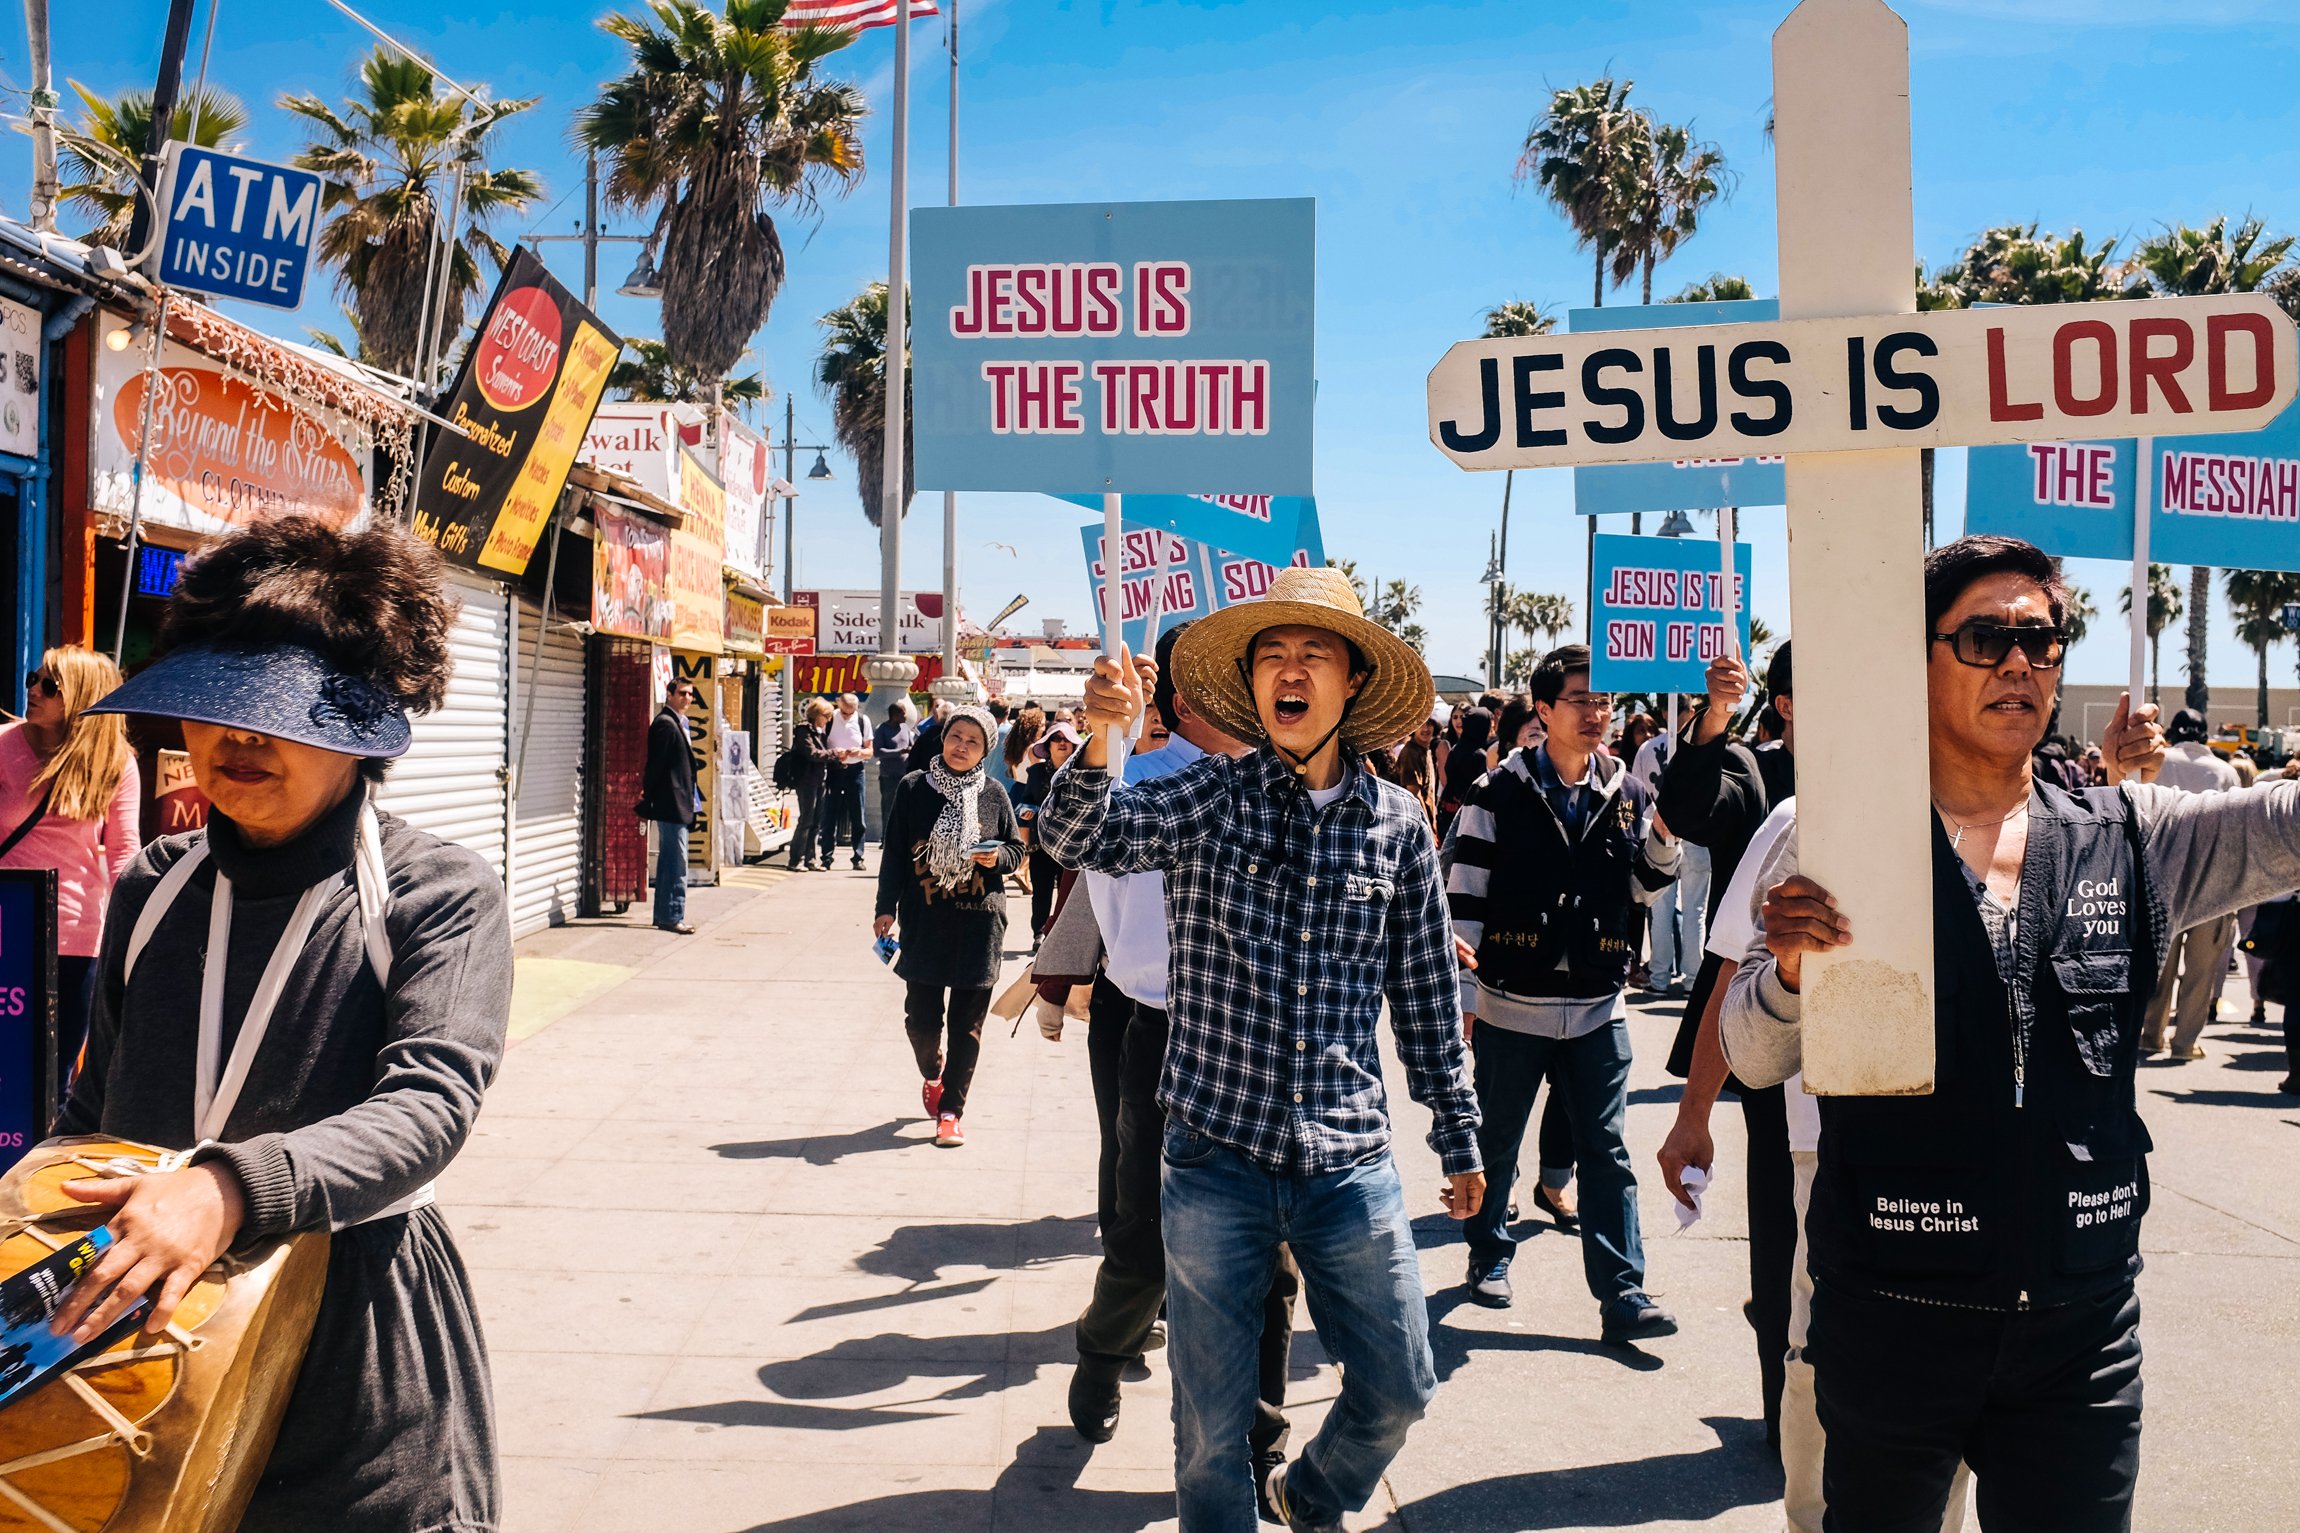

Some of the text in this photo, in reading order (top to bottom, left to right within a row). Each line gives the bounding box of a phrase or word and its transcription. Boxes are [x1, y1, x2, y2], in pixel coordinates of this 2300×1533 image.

[173, 158, 317, 248] ATM
[173, 238, 294, 294] INSIDE
[953, 266, 1186, 334] JESUS IS
[489, 302, 559, 375] WEST COAST
[985, 364, 1266, 431] THE TRUTH
[1439, 312, 2276, 453] JESUS IS LORD
[150, 371, 353, 489] Beyond the Stars
[452, 401, 518, 458] Personalized
[441, 461, 481, 502] Custom
[2031, 445, 2298, 518] THE MESSIAH
[412, 509, 469, 555] Made Gifts
[1605, 569, 1676, 607] JESUS
[1683, 573, 1701, 608] IS
[770, 614, 811, 628] Kodak
[1608, 622, 1725, 659] SON OF GO
[2065, 898, 2127, 917] Loves
[2077, 877, 2120, 899] God
[2082, 919, 2120, 938] you
[1877, 1197, 1964, 1214] Believe in
[2068, 1181, 2139, 1208] Please don't
[2076, 1200, 2131, 1228] go to Hell
[1920, 1215, 1980, 1232] Christ
